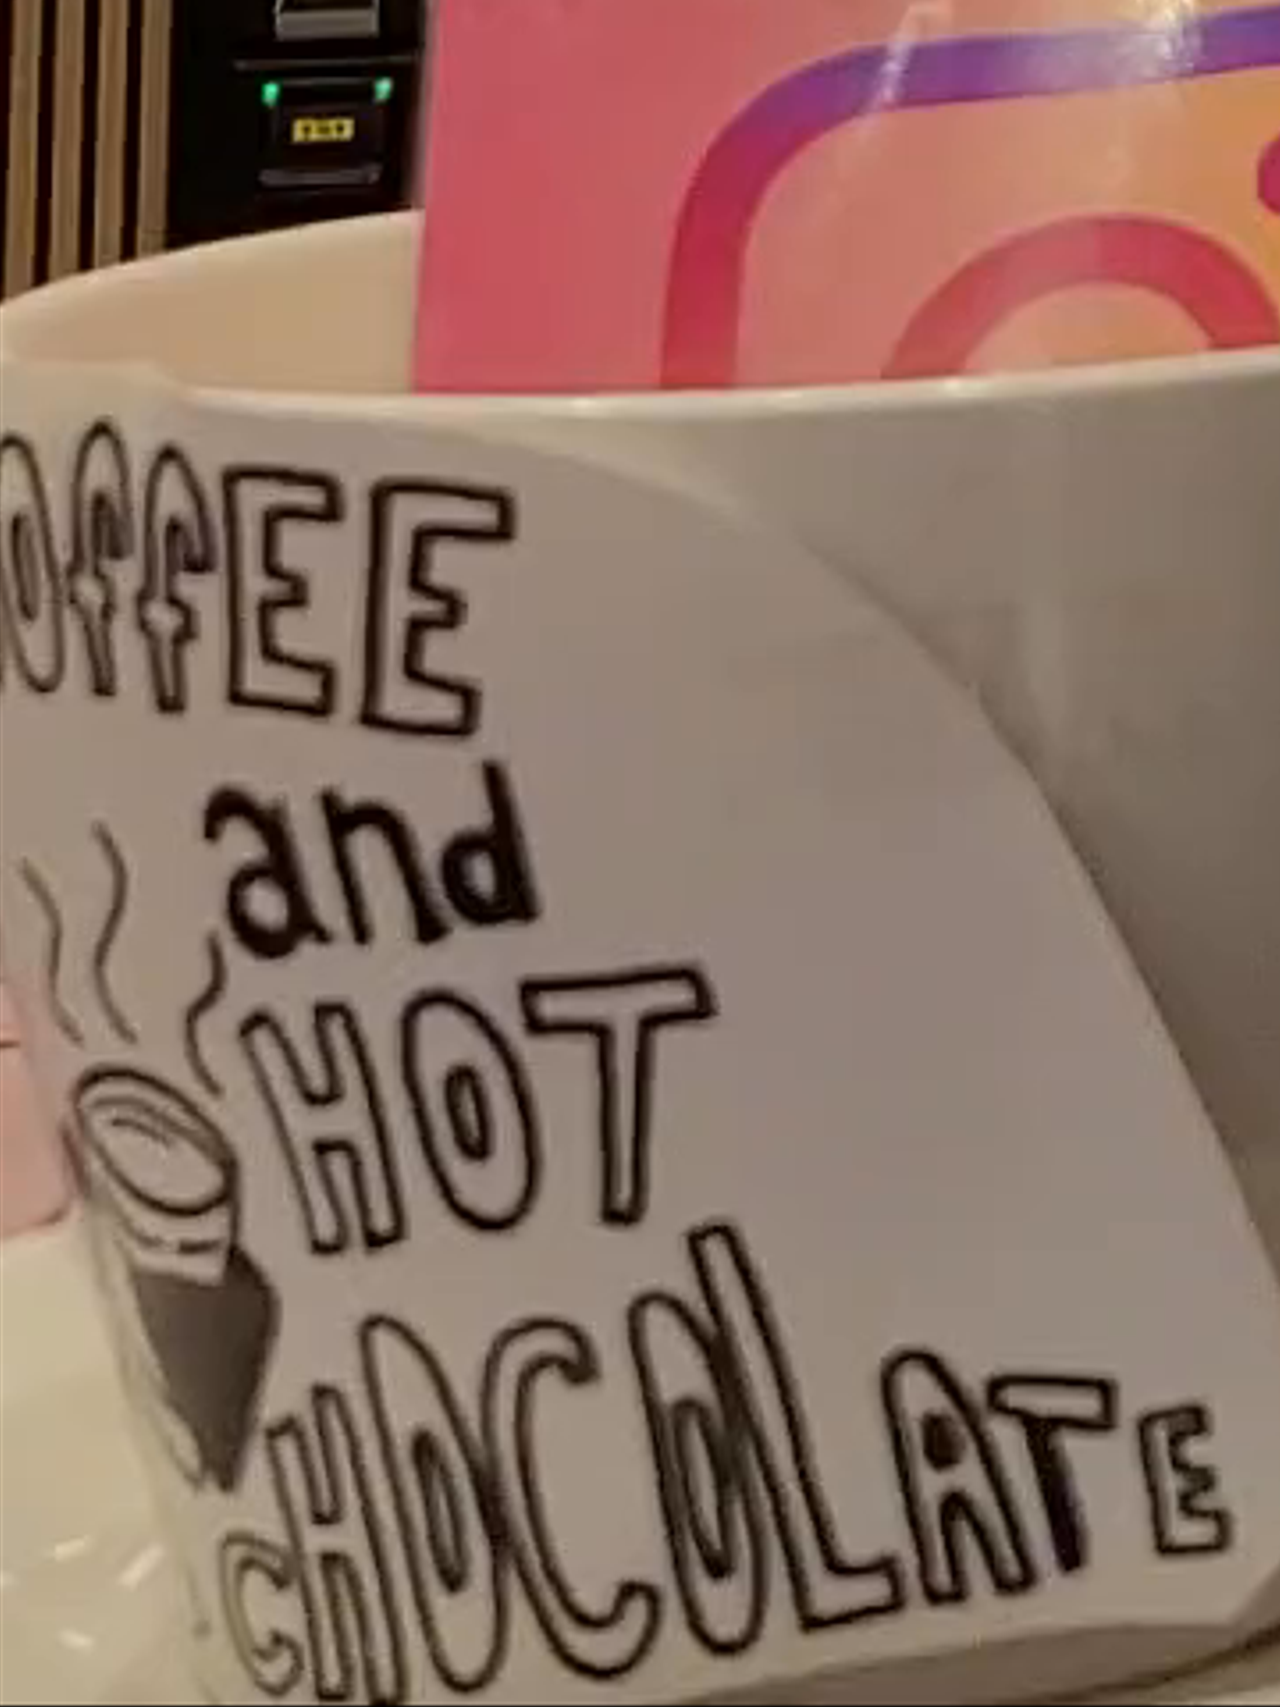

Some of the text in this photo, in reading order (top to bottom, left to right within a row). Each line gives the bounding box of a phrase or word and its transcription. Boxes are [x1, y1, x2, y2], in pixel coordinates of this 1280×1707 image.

[202, 759, 541, 960] and
[238, 962, 718, 1256] HOT
[219, 1221, 1235, 1705] CHOCOLATE
